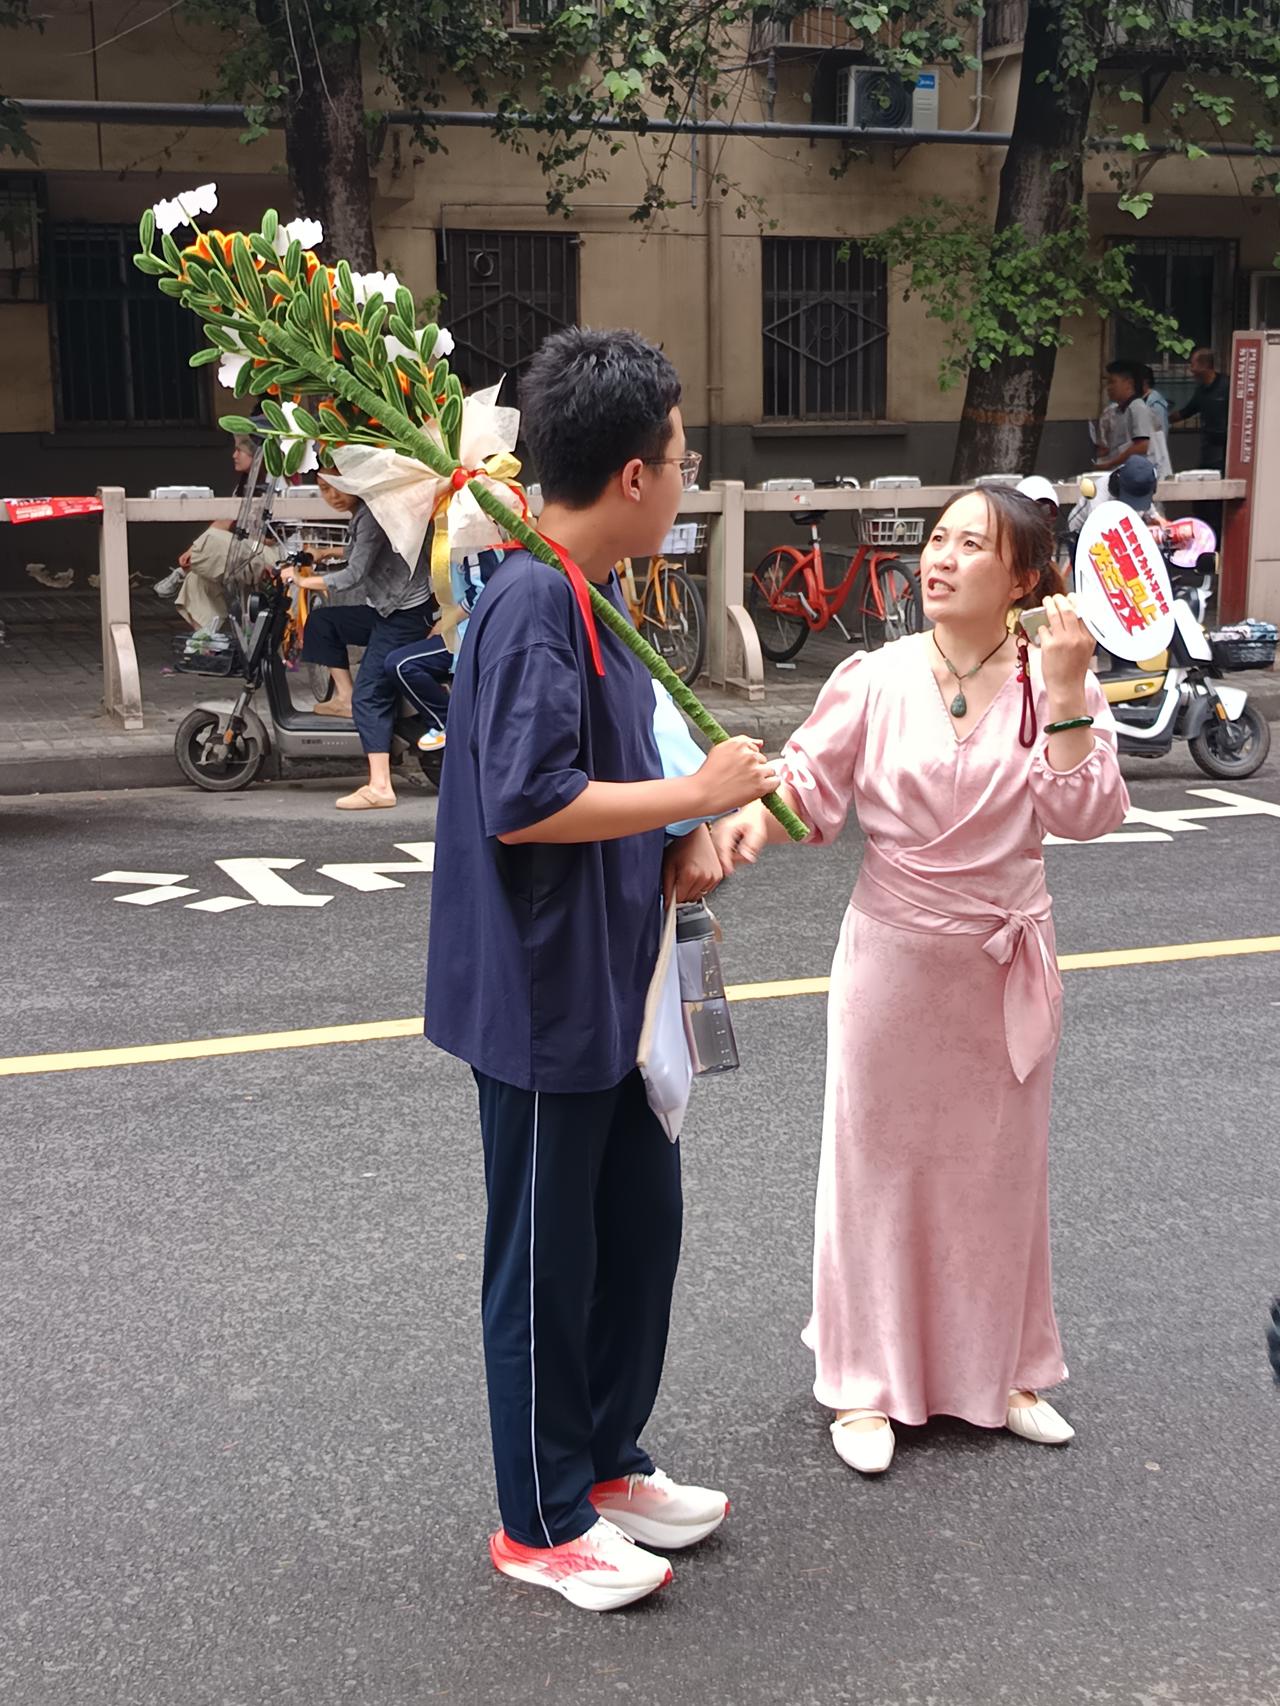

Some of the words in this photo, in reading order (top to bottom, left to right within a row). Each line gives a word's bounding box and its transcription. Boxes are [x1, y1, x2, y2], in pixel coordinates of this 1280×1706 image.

[1248, 348, 1257, 396] PUBLIC
[1089, 542, 1145, 636] 光芒万丈
